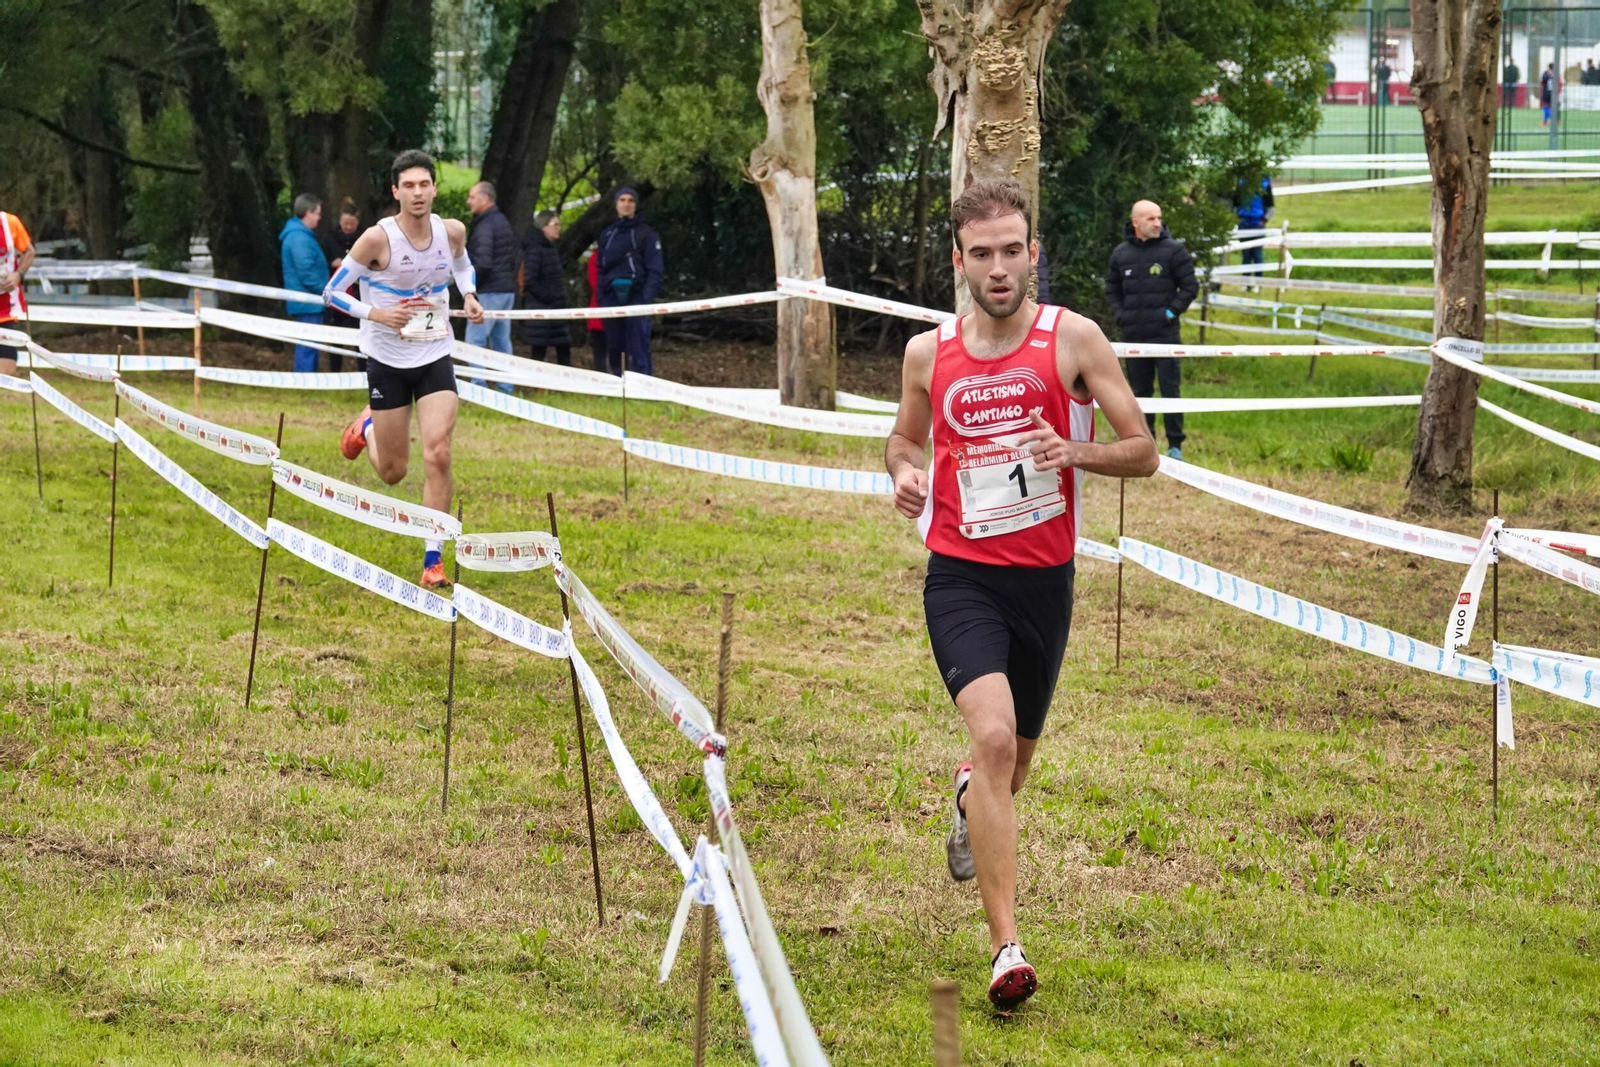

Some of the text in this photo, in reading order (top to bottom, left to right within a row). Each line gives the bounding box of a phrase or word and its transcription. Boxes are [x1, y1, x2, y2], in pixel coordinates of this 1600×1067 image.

[425, 312, 434, 330] 2
[961, 383, 1026, 404] ATLETISMO
[963, 404, 1023, 425] SANTIAGO
[966, 444, 1003, 456] MEMORIAL
[968, 454, 1008, 468] BELARMINO
[1008, 463, 1028, 498] 1
[1454, 609, 1466, 639] VIGO
